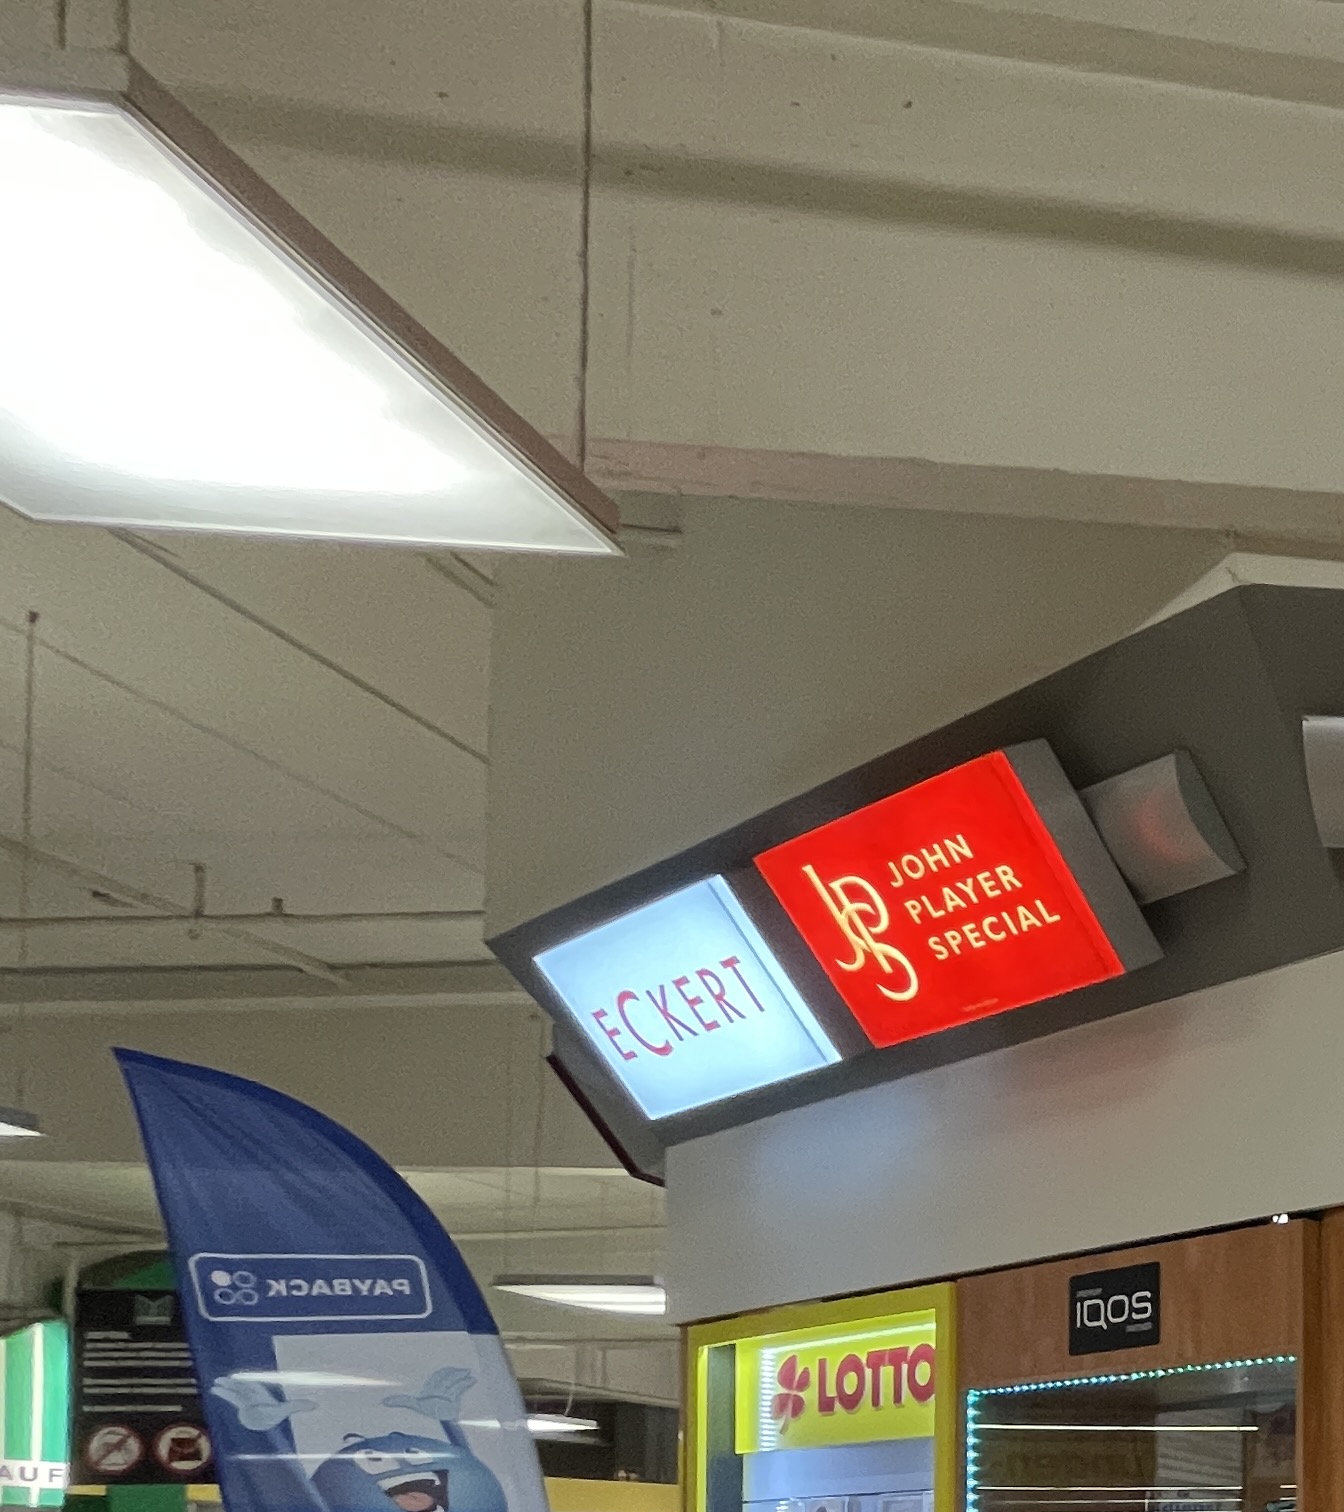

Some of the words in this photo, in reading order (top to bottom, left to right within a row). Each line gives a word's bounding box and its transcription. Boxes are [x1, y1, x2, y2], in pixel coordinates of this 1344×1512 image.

[887, 833, 975, 890] JOHN
[903, 863, 1023, 926] PLAYER
[927, 899, 1062, 962] SPECIAL
[590, 955, 766, 1063] ECKERT
[1076, 1291, 1152, 1330] IQOS
[818, 1342, 936, 1415] LOTTO
